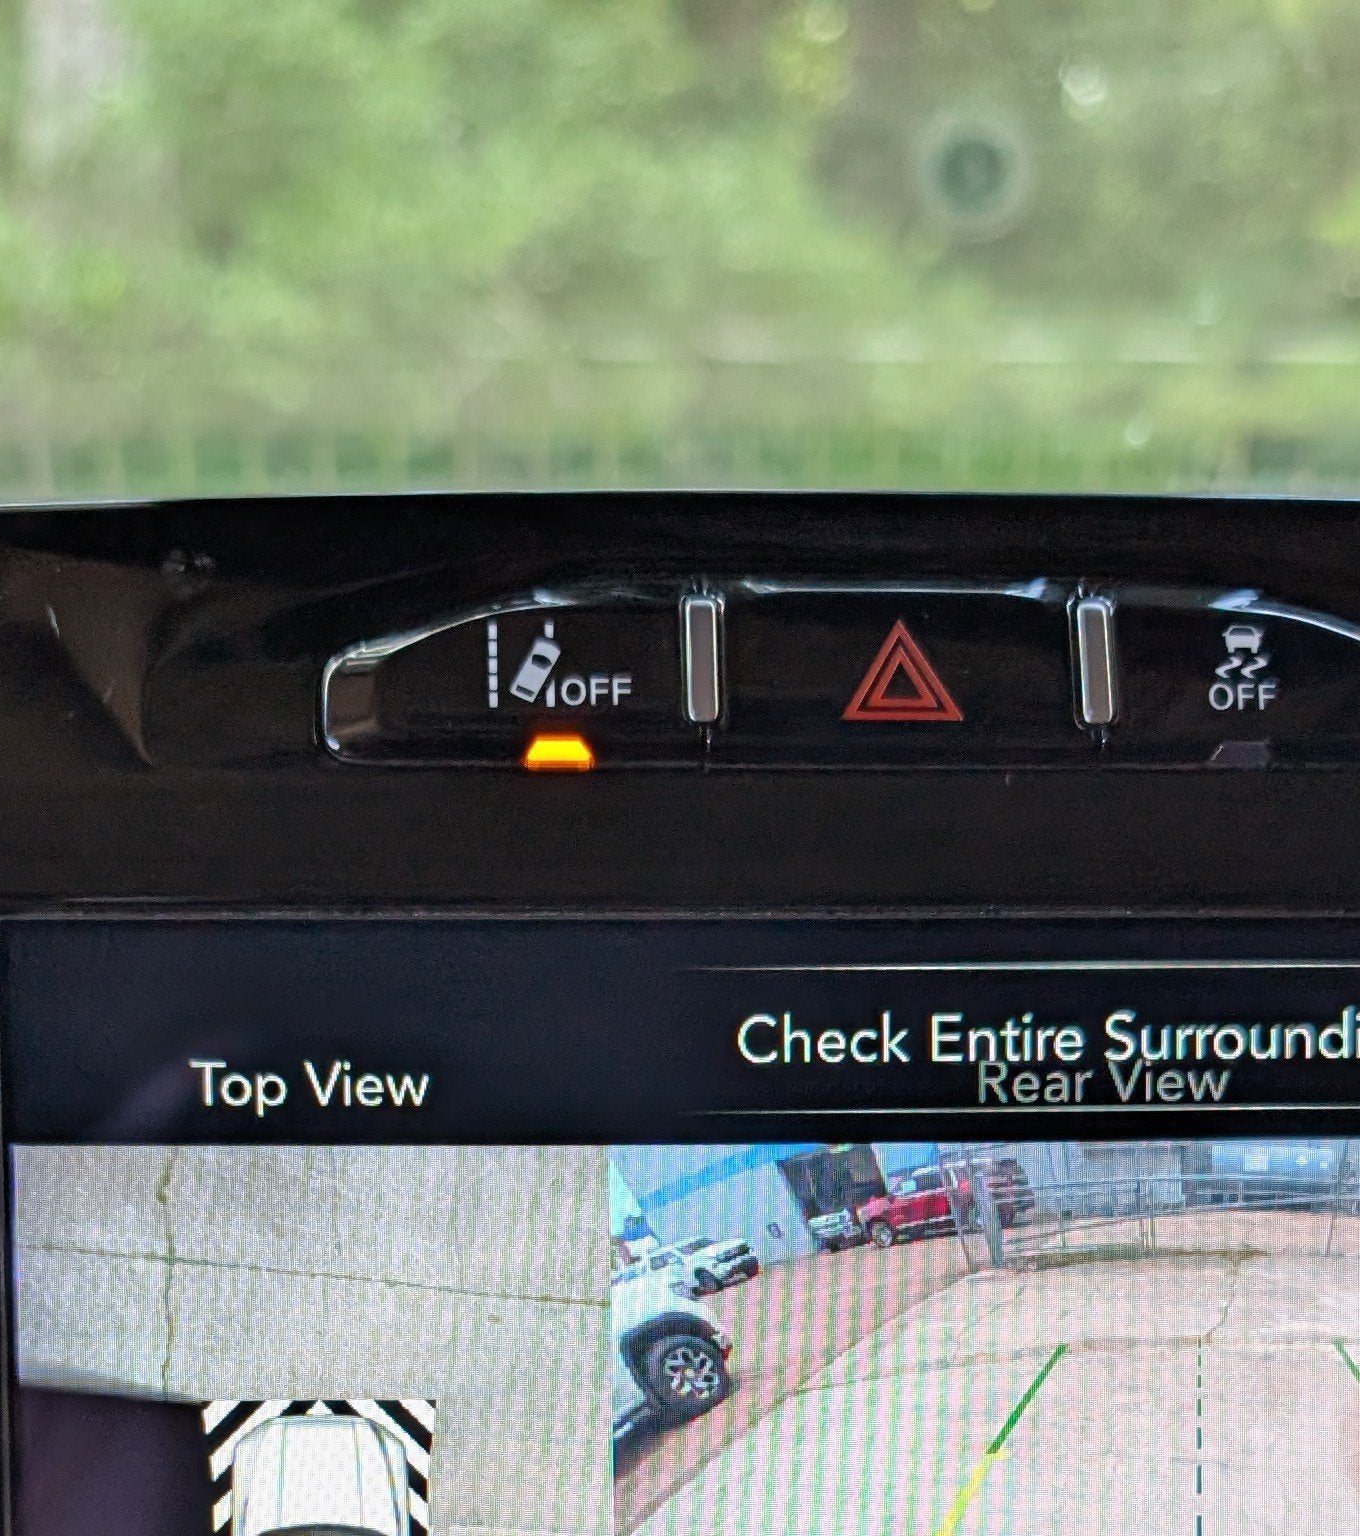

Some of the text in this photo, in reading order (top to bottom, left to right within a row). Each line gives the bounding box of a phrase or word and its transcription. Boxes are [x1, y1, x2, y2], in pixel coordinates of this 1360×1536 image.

[560, 677, 633, 706] OFF
[1208, 683, 1277, 712] OFF
[736, 1014, 910, 1065] Check
[930, 1014, 1085, 1064] Entire
[190, 1059, 430, 1116] Top View
[976, 1060, 1231, 1107] Rear View
